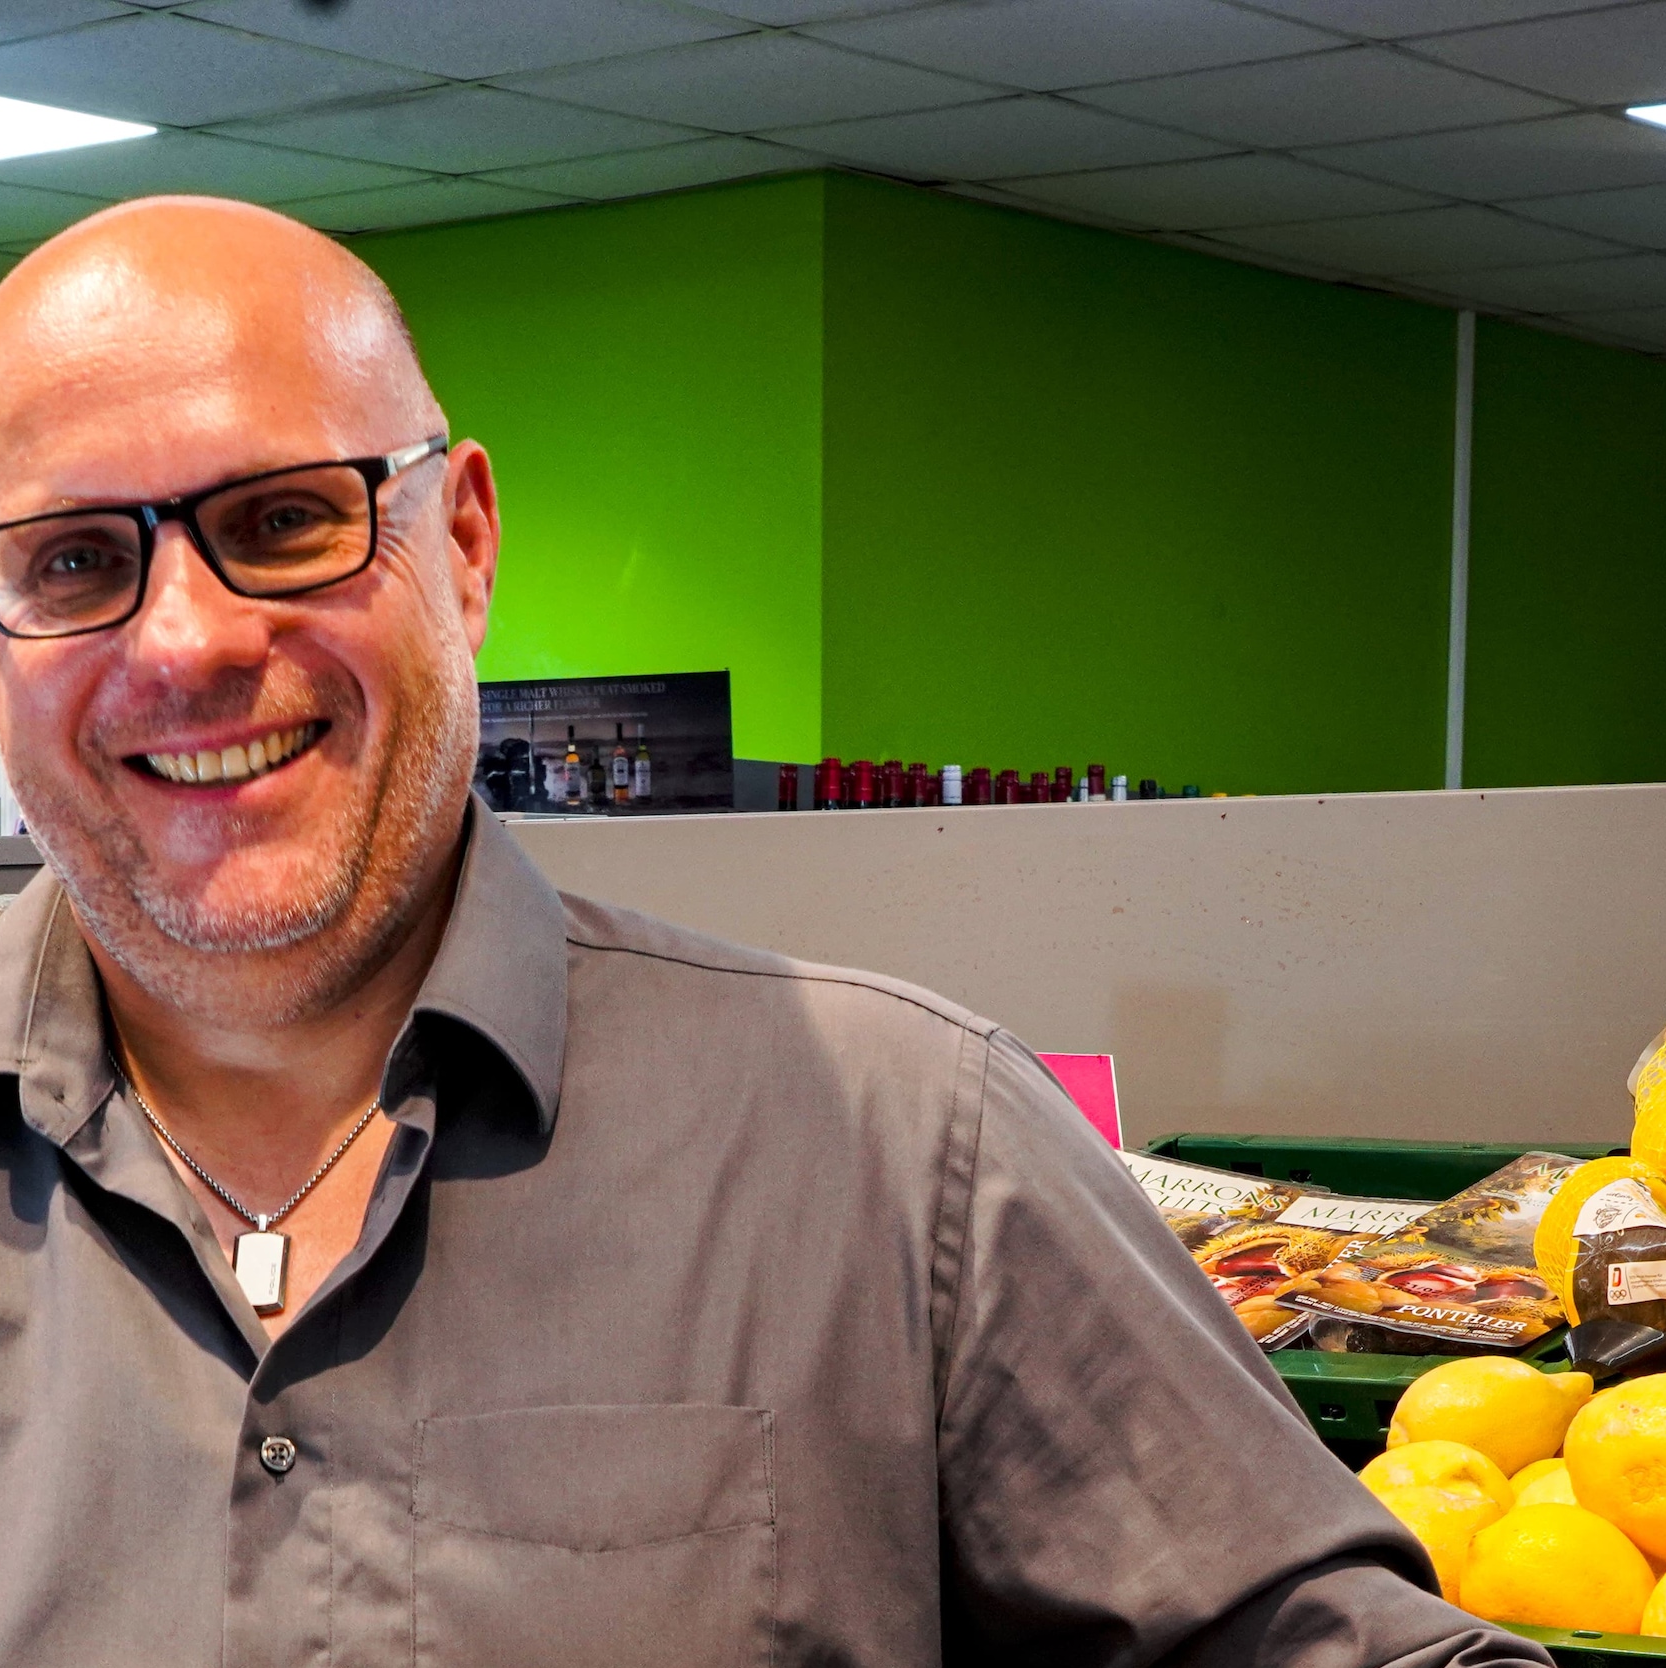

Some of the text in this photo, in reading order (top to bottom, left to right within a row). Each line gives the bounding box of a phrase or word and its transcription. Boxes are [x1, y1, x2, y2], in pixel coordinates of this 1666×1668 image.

[519, 687, 547, 699] MALT
[594, 684, 620, 696] PEAT
[621, 681, 665, 695] SMOKED
[482, 701, 502, 712] FOR
[514, 699, 551, 711] RICHER
[1395, 1304, 1528, 1332] PONTHIER
